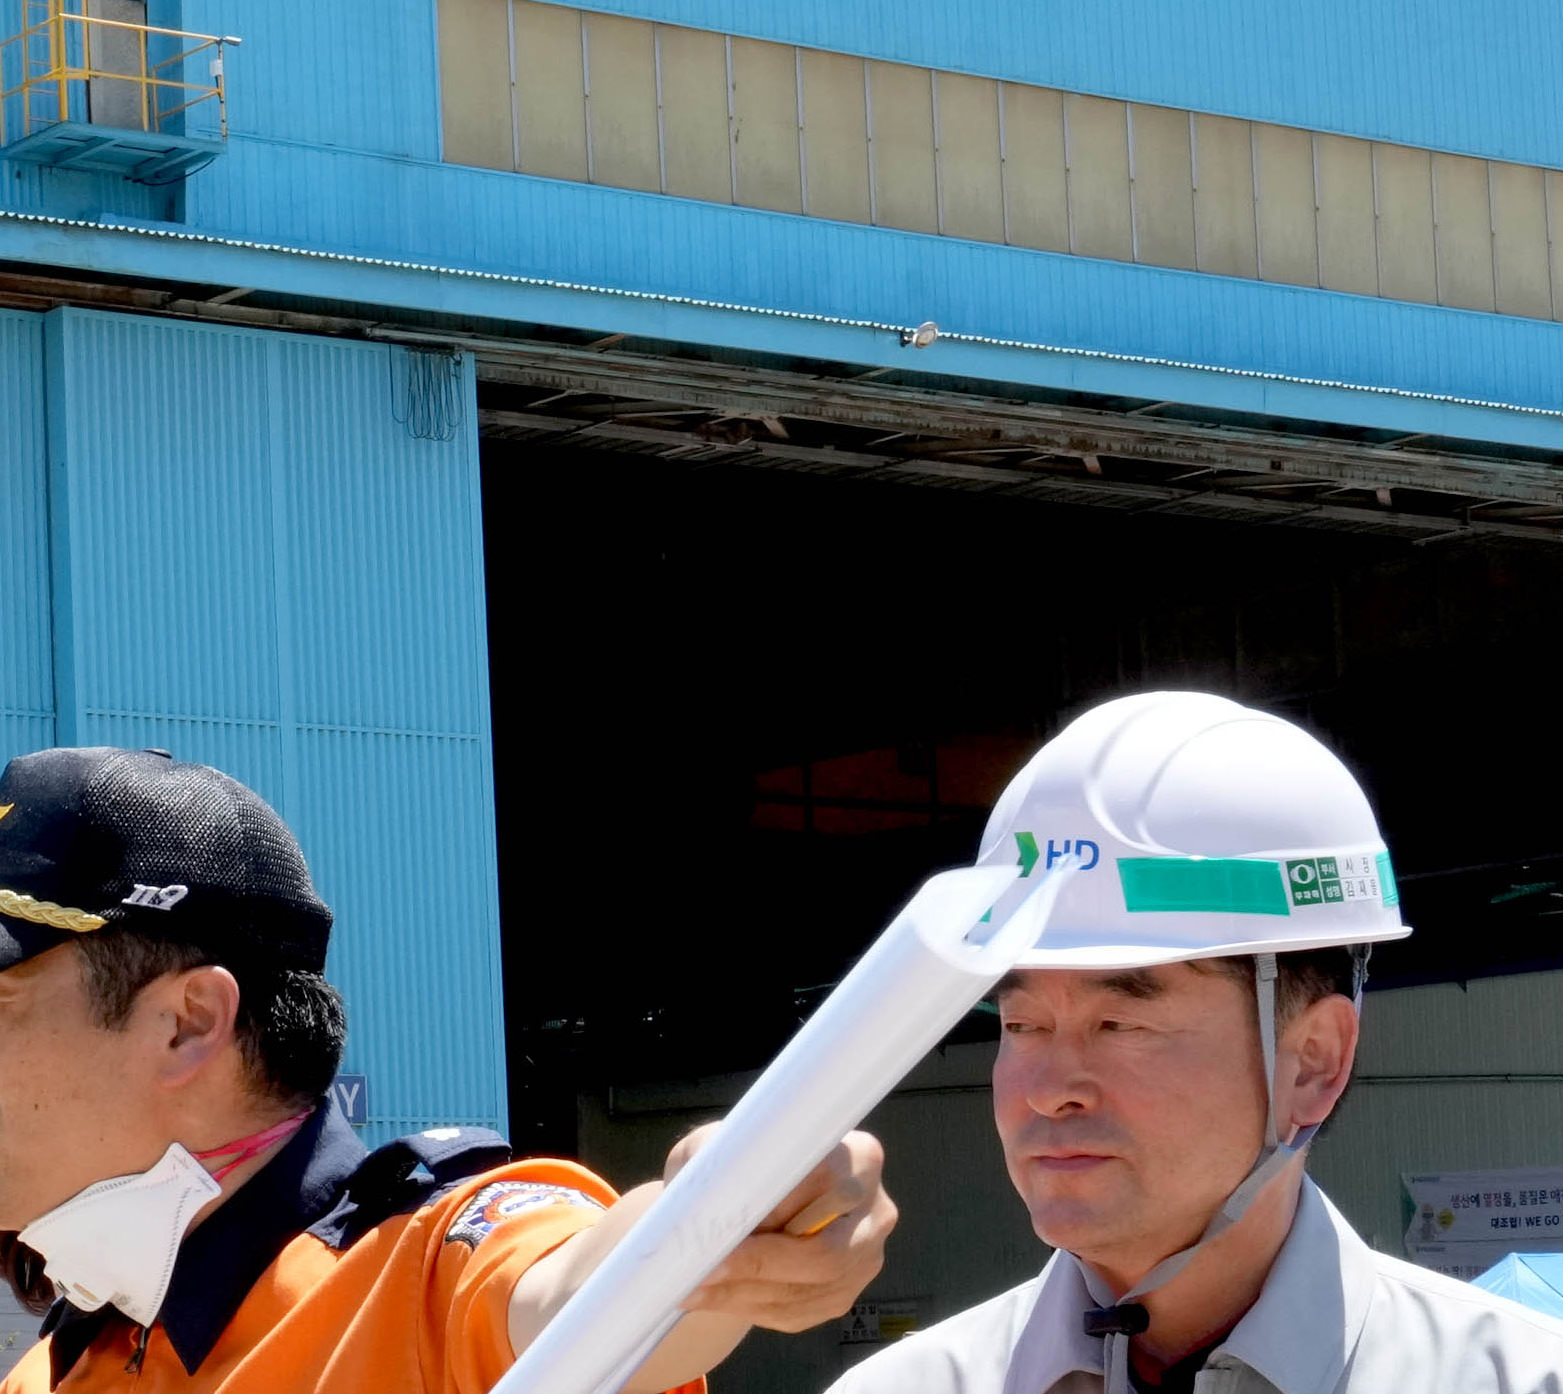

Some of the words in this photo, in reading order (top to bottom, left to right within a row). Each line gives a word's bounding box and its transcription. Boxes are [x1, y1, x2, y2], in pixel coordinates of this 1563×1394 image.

[1046, 839, 1100, 871] HD
[121, 883, 189, 911] 119
[1525, 1216, 1542, 1227] WE
[1545, 1215, 1560, 1226] GO
